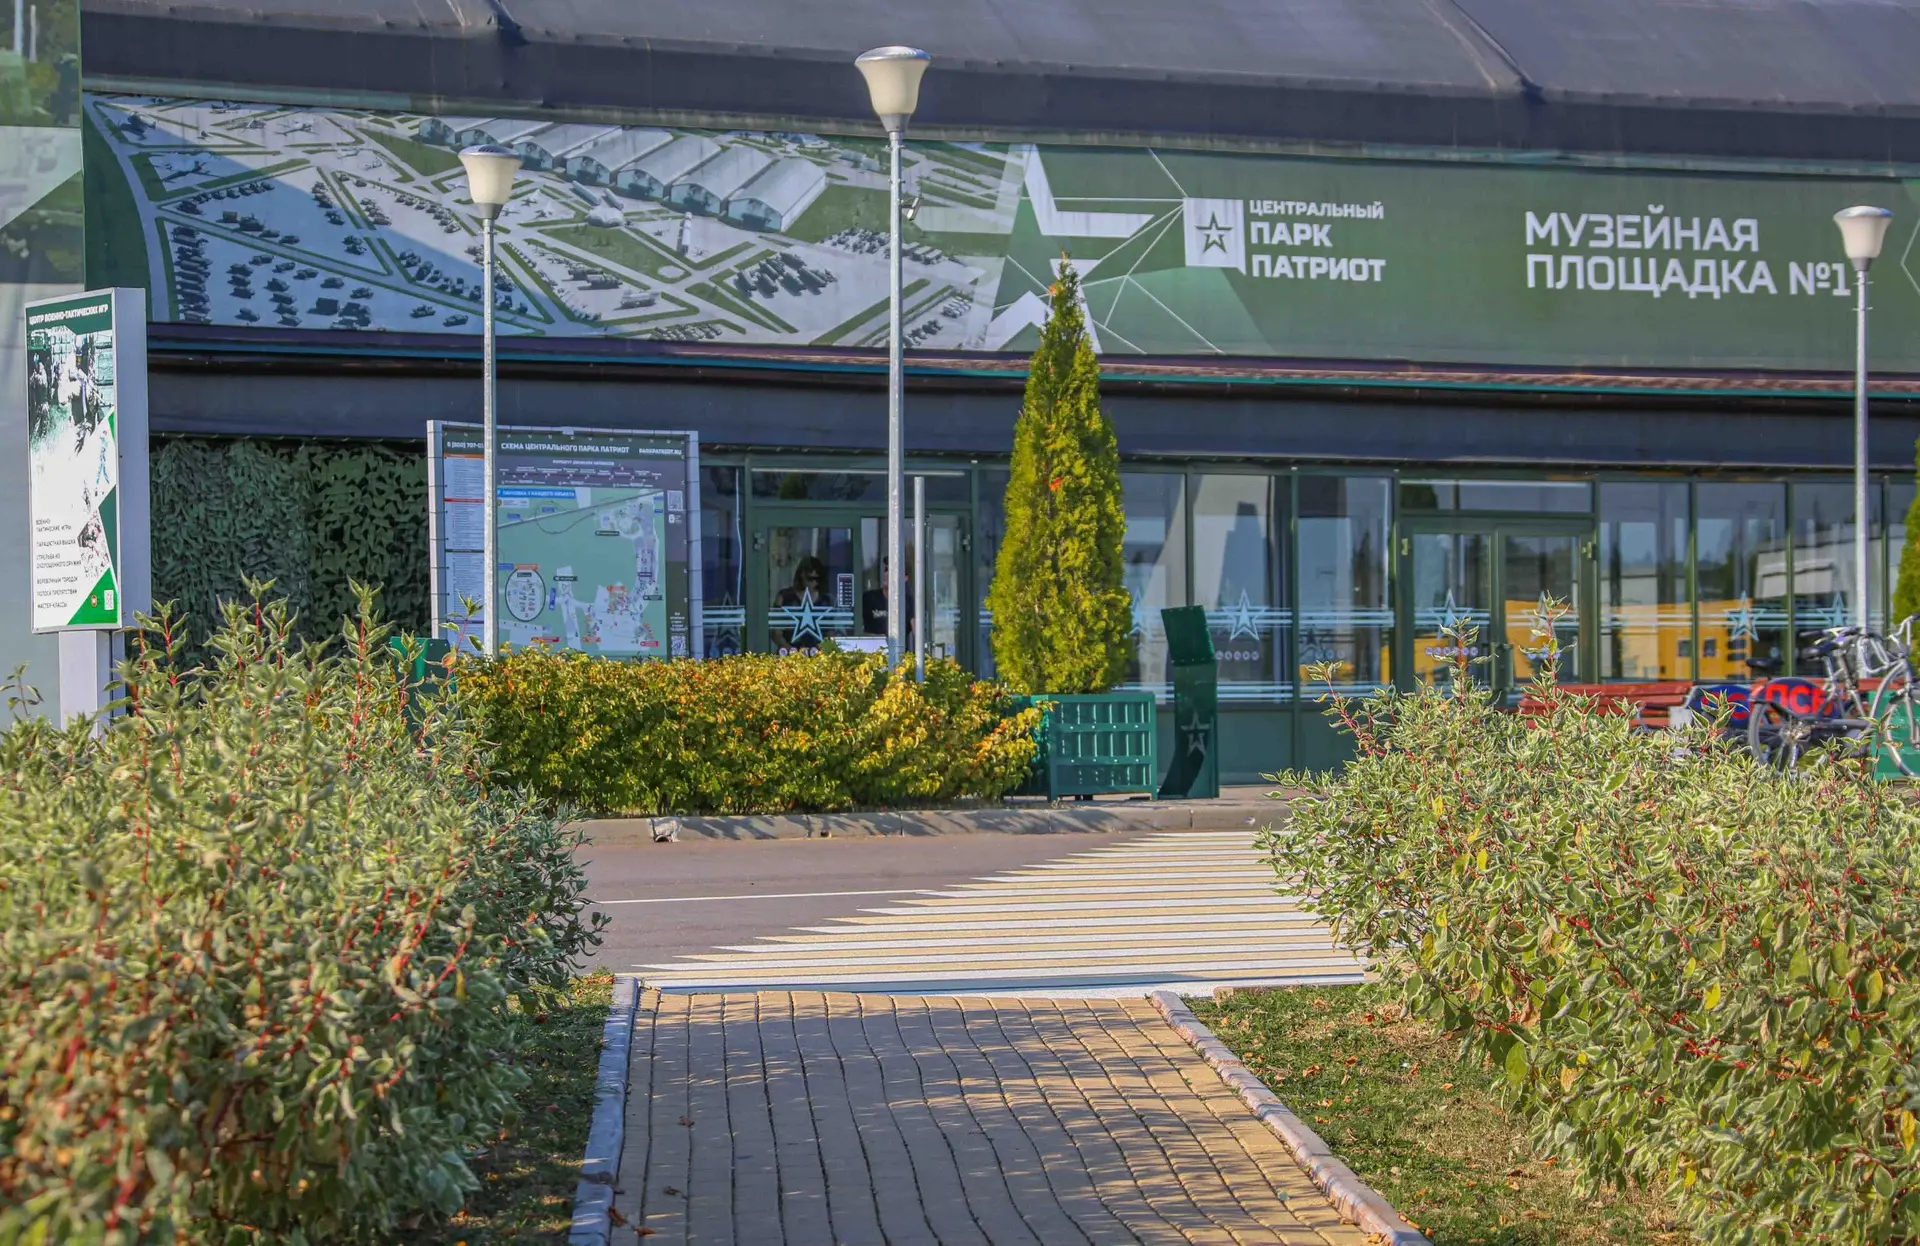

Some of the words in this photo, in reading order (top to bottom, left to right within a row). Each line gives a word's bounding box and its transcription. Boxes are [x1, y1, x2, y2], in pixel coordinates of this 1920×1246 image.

[1249, 199, 1385, 220] ЦЕНТРАЛЬНЫЙ
[1250, 221, 1333, 247] ПАРК
[1525, 203, 1759, 252] МУЗЕЙНАЯ
[1251, 254, 1386, 282] ПАТРИОТ
[1527, 254, 1778, 299] ПЛОЩАДКА
[1788, 261, 1851, 296] №1
[525, 443, 577, 452] ЦЕНТРАЛЬНОГО
[578, 445, 600, 453] ПАРКА
[600, 446, 630, 454] ПАТРИОТ
